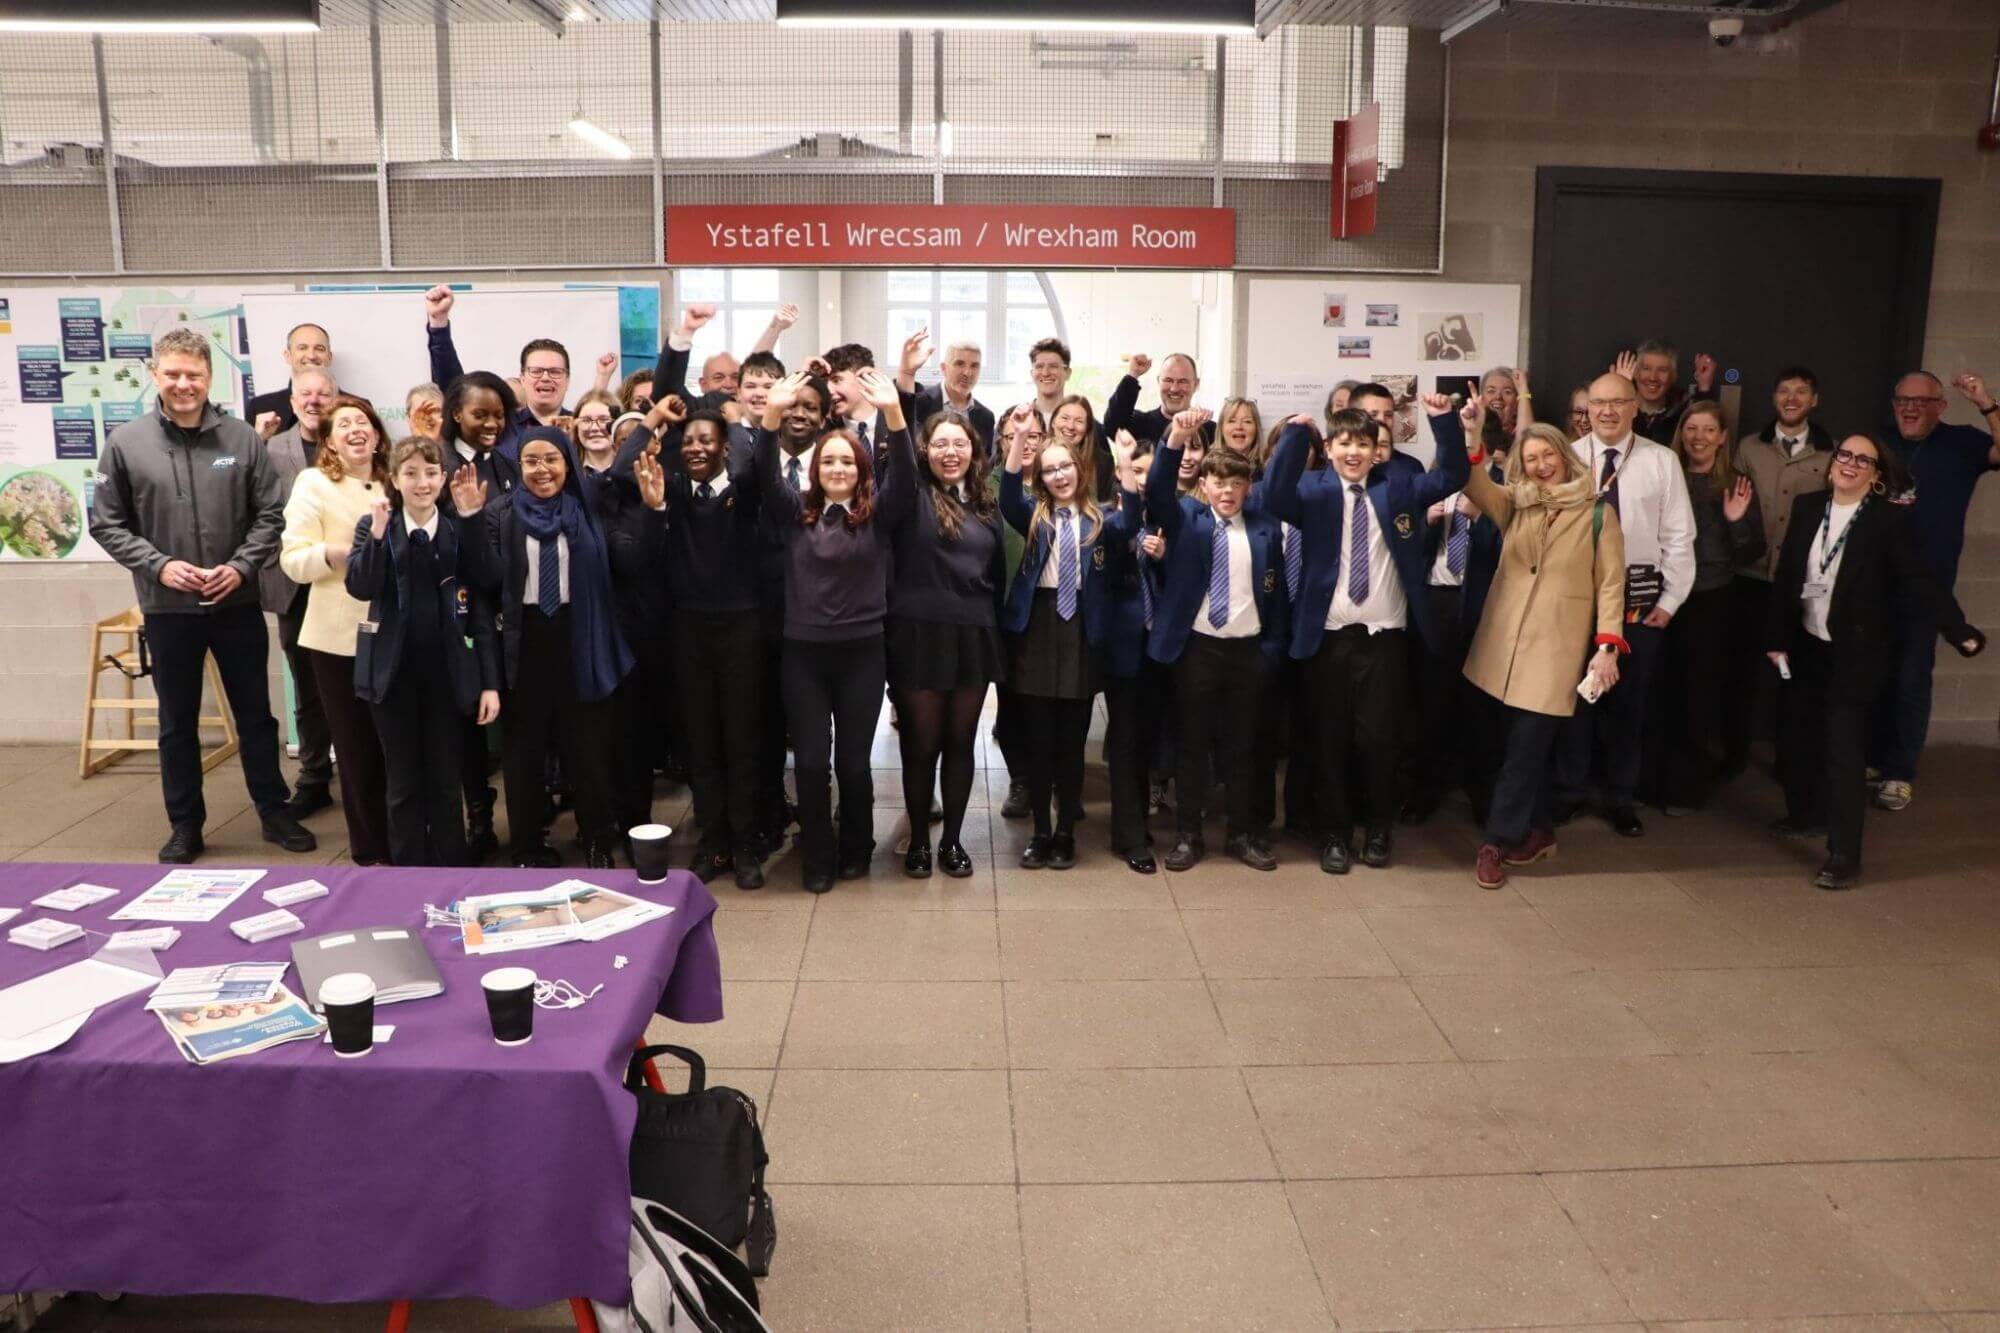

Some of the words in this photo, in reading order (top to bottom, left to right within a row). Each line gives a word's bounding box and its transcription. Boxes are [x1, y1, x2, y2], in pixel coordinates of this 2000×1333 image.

[706, 223, 830, 247] Ystafell
[846, 222, 961, 247] Wrecsam
[975, 222, 988, 247] /
[1004, 222, 1118, 248] Wrexham
[1132, 224, 1196, 248] Room
